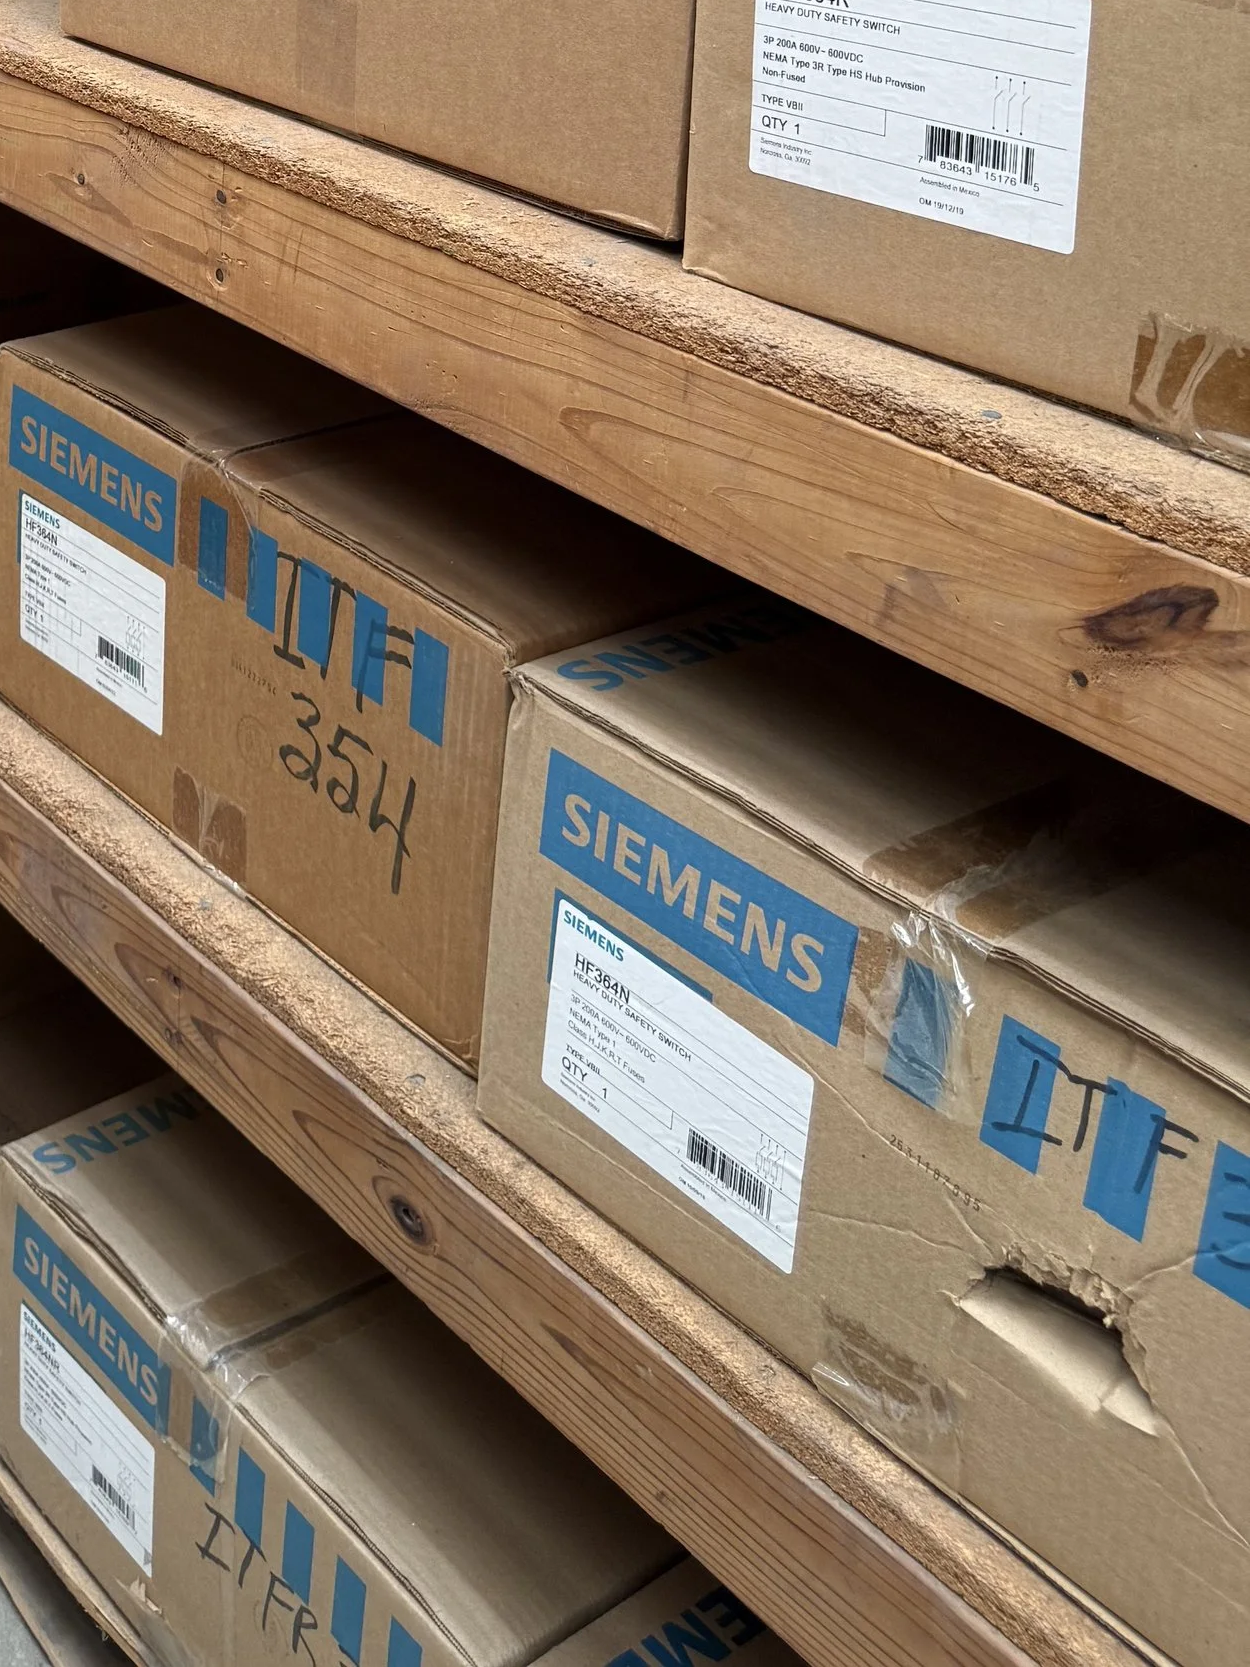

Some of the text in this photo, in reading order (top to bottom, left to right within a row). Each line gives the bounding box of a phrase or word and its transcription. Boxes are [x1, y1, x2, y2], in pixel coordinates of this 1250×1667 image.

[764, 1, 901, 35] HEAVY DUTY SAFETY SWITCH
[763, 35, 775, 46] 3P
[776, 37, 798, 51] 200A
[827, 47, 864, 64] 600VDC
[762, 66, 806, 84] Non-Fused
[763, 51, 926, 94] NEMA Type 3R Type HS Hub Provision
[761, 94, 784, 108] TYPE
[761, 114, 801, 135] QTY 1
[917, 155, 1040, 193] 7 83643 15176 5
[918, 197, 932, 208] OM
[20, 414, 163, 534] SIEMENS
[25, 500, 60, 530] SIEMENS
[25, 519, 58, 547] HF364N
[25, 603, 38, 618] QTY
[273, 549, 417, 713] ITF
[279, 691, 417, 895] 354
[561, 794, 825, 993] SIEMENS
[563, 910, 624, 962] SIEMENS
[576, 952, 630, 1004] HF364N
[568, 1007, 591, 1026] NEMA
[592, 1019, 610, 1042] Type
[571, 993, 581, 1007] 3P
[581, 999, 600, 1021] 200A
[625, 1033, 656, 1064] 600VDC
[573, 969, 692, 1063] HEAVY DUTY SAFETY SWITCH
[567, 1020, 588, 1042] Class
[623, 1058, 646, 1084] Fuses
[561, 1057, 589, 1083] QTY
[601, 1088, 608, 1100] 1
[991, 1034, 1200, 1193] ITF
[23, 1236, 159, 1406] SIEMENS
[23, 1311, 57, 1354] SIEMENS
